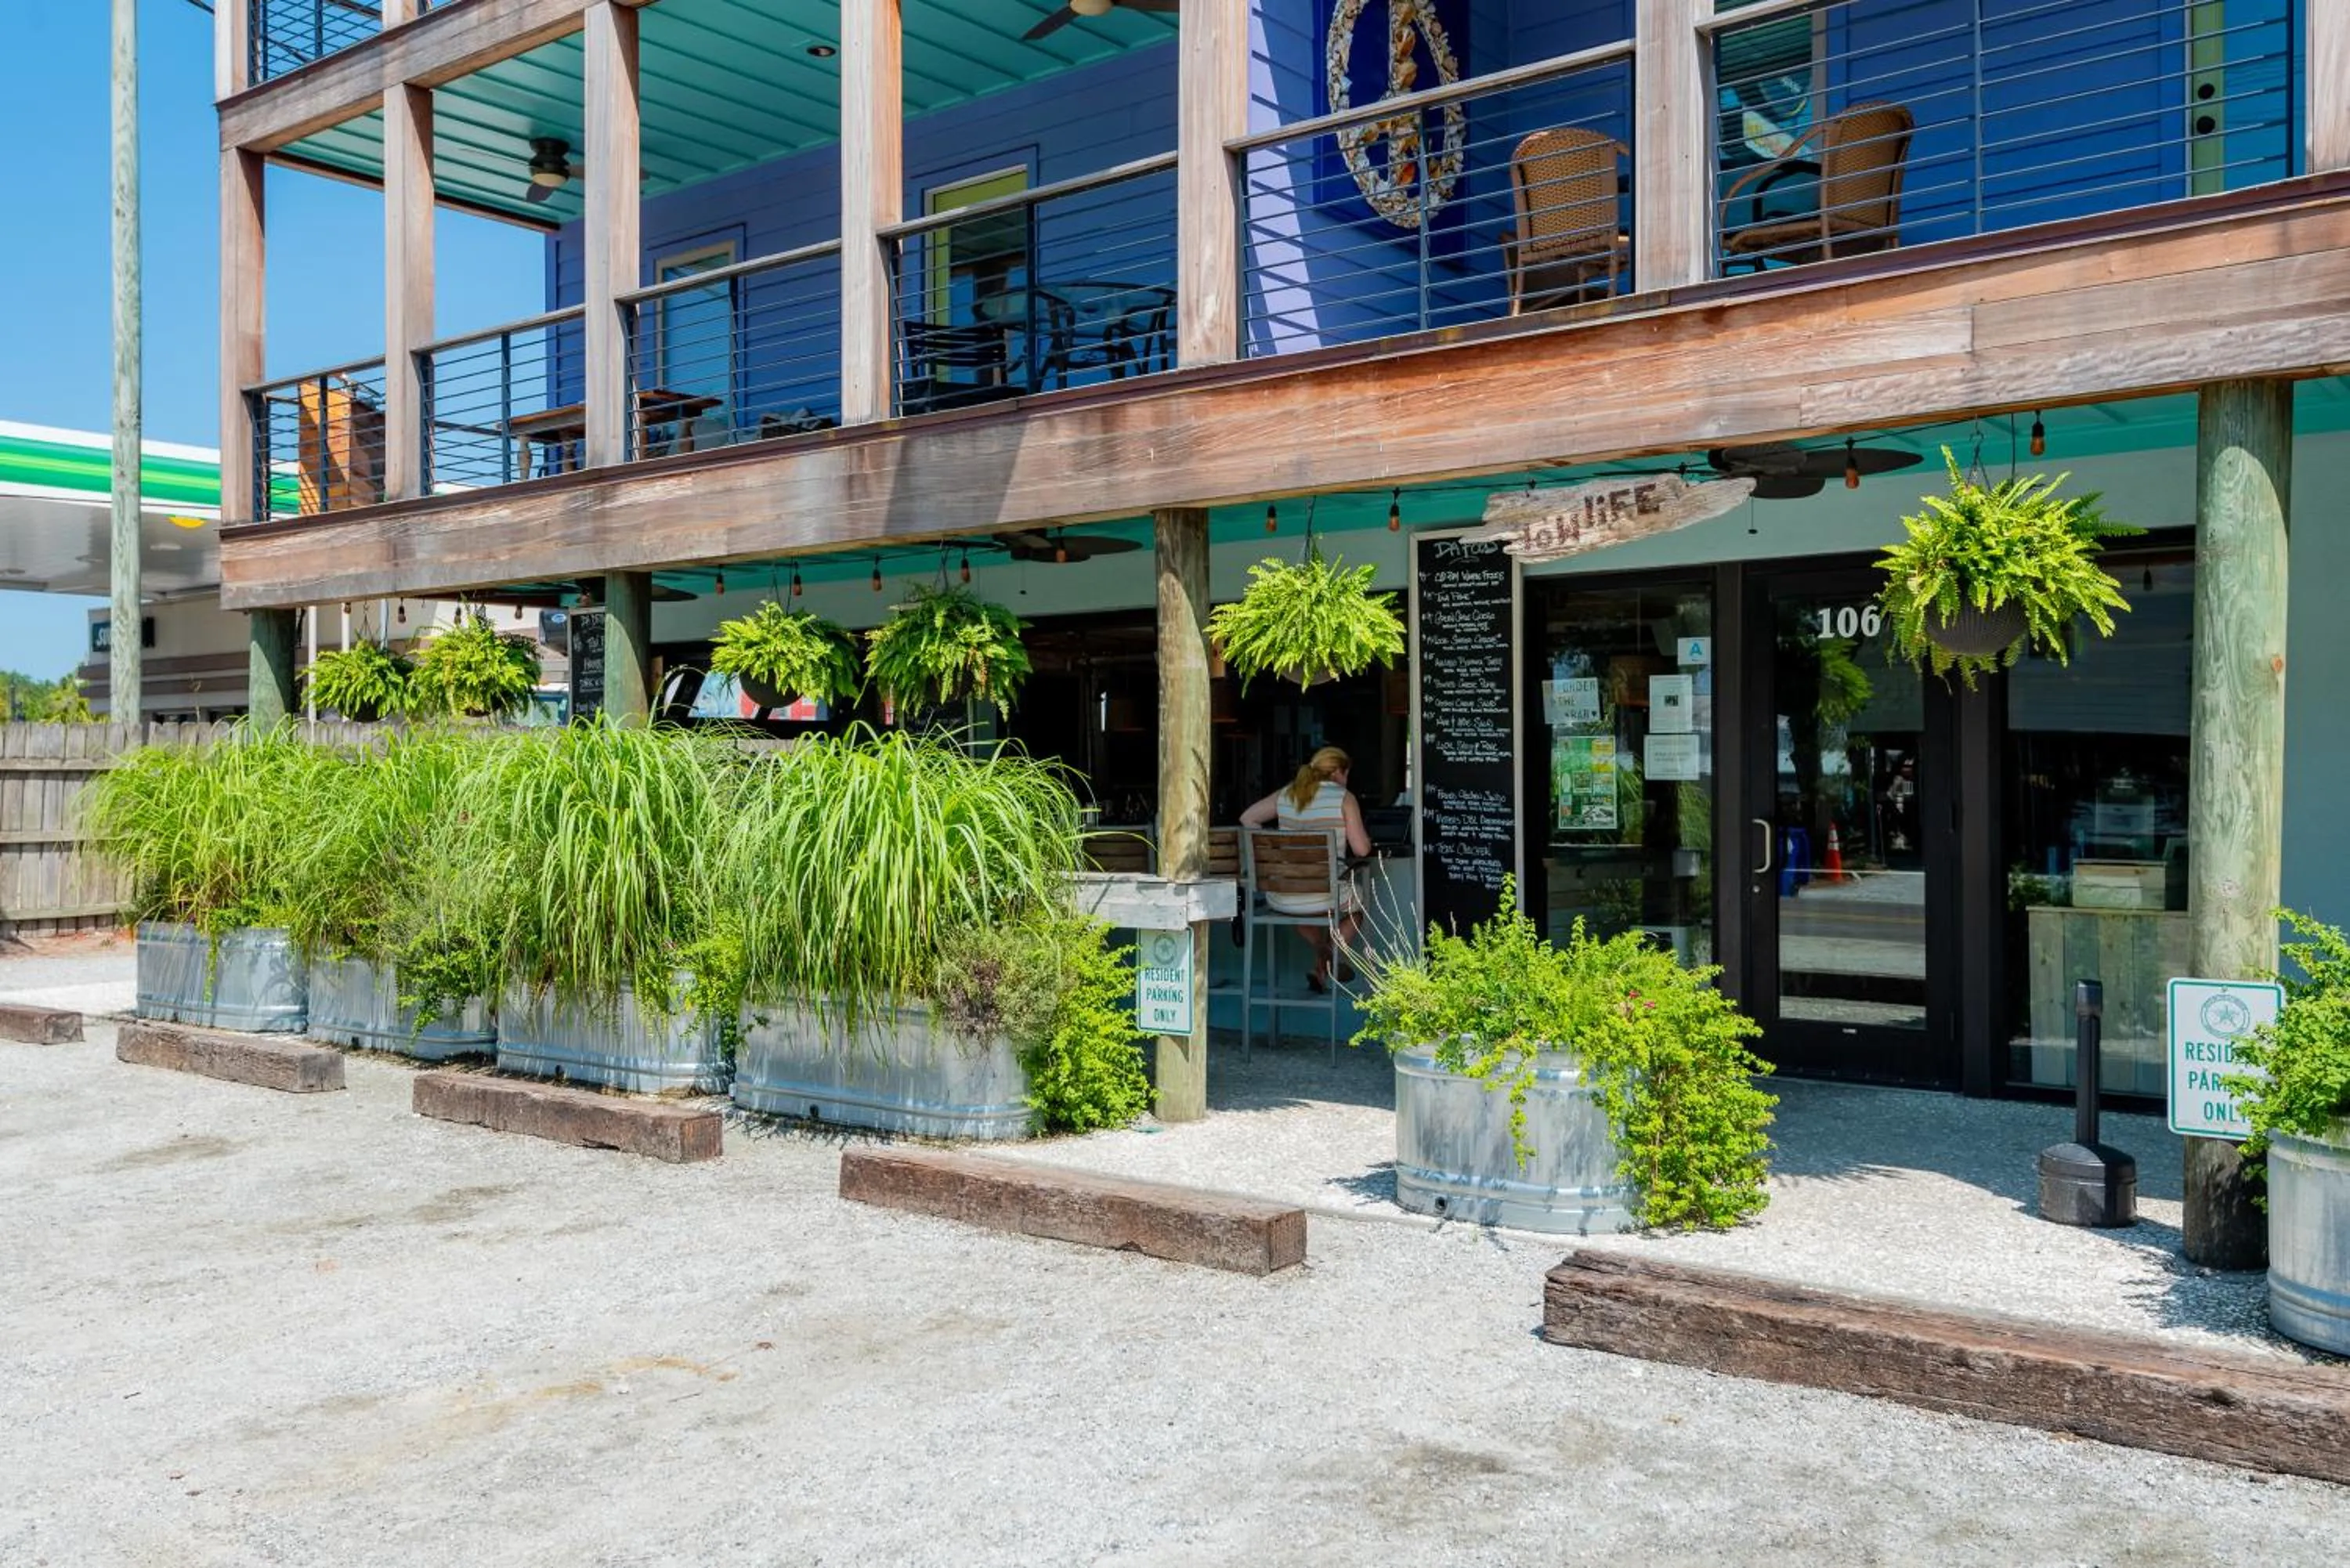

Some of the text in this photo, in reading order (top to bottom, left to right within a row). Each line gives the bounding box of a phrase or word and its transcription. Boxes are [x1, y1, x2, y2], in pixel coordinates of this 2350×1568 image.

[1817, 605, 1880, 639] 106
[1690, 642, 1702, 656] A
[1144, 967, 1185, 983] RESIDENT
[1146, 987, 1184, 1003] PARKING
[1153, 1008, 1177, 1022] ONLY
[2185, 1040, 2233, 1063] RESID
